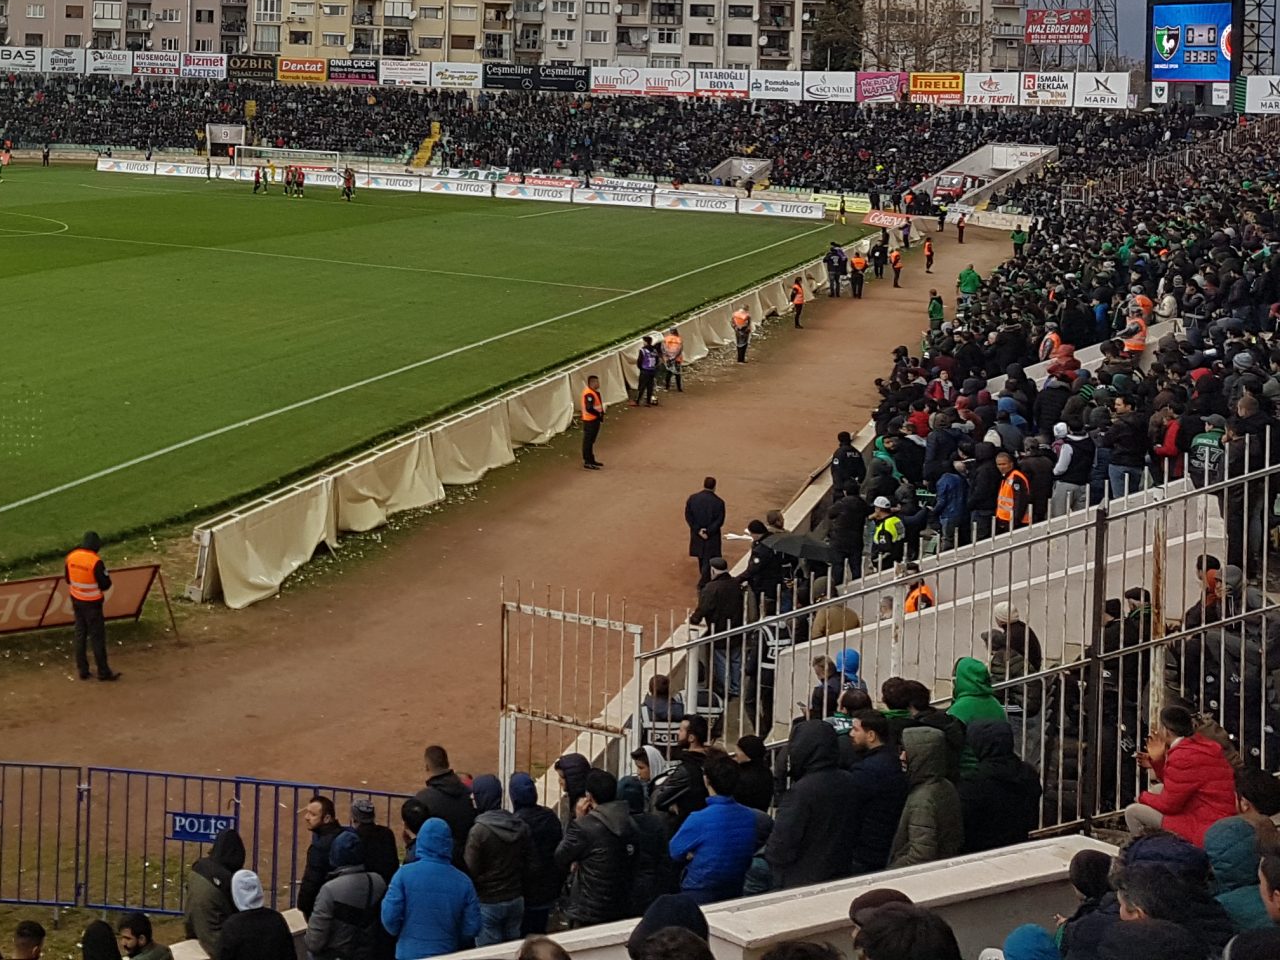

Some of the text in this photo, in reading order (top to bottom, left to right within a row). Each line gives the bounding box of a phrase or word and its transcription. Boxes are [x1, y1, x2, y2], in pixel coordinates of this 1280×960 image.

[1027, 25, 1045, 34] AYAZ
[1070, 25, 1088, 34] BOYA
[1186, 27, 1195, 44] 0
[1208, 27, 1216, 44] 0
[184, 54, 225, 67] Hizmet
[330, 59, 352, 67] ONUR
[282, 60, 323, 72] Dentat
[487, 64, 533, 75] Çeşmeliler
[540, 66, 587, 78] Çeşmeliler
[700, 70, 745, 80] TATAROĞLU
[913, 75, 960, 89] PIRELLI
[1037, 74, 1064, 83] İSMAİL
[709, 80, 734, 90] BOYA
[1037, 83, 1069, 91] REKLAM
